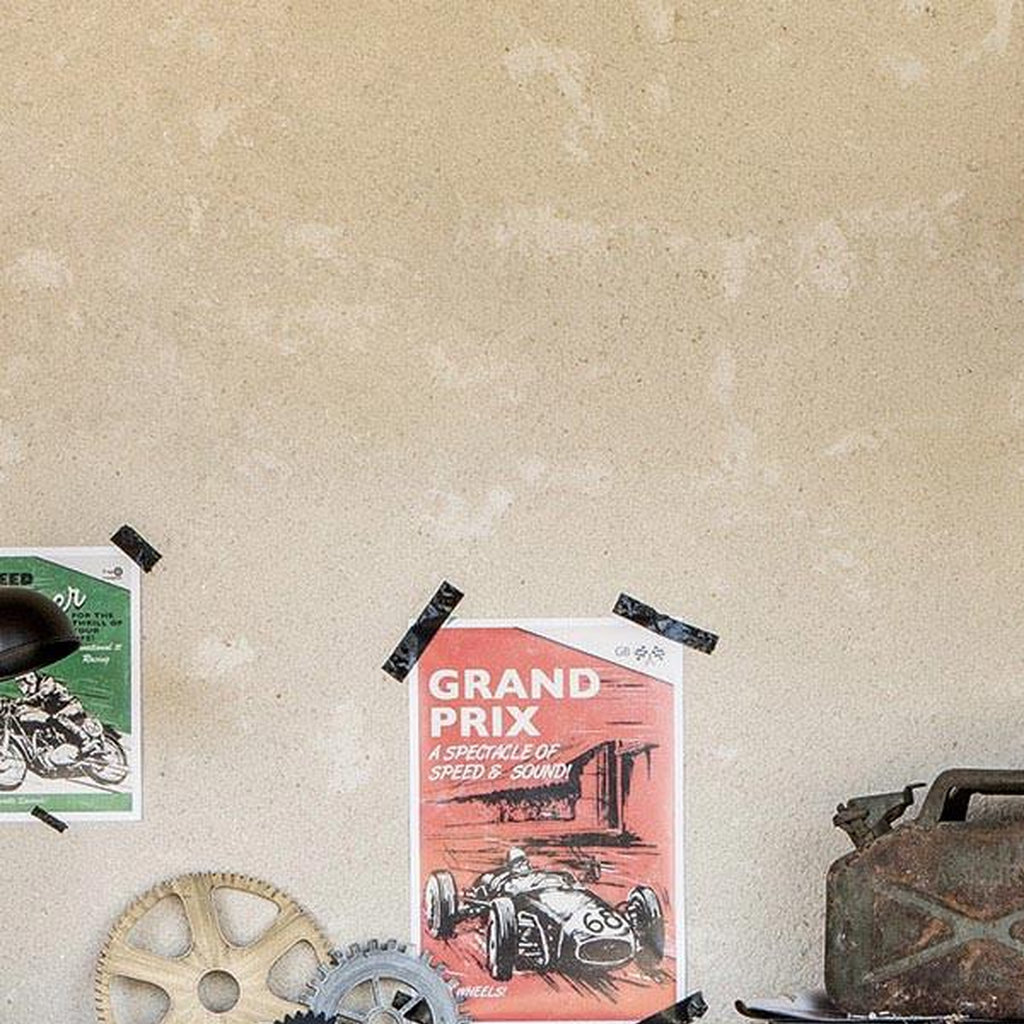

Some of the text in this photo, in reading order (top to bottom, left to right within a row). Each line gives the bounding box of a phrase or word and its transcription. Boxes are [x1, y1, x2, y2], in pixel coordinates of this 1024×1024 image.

[614, 646, 631, 657] GB
[428, 668, 601, 700] GRAND
[430, 706, 541, 737] PRIX
[428, 744, 561, 760] A SPECTACLE OF
[428, 763, 573, 781] SPEED & SOUND!
[583, 909, 623, 934] 68
